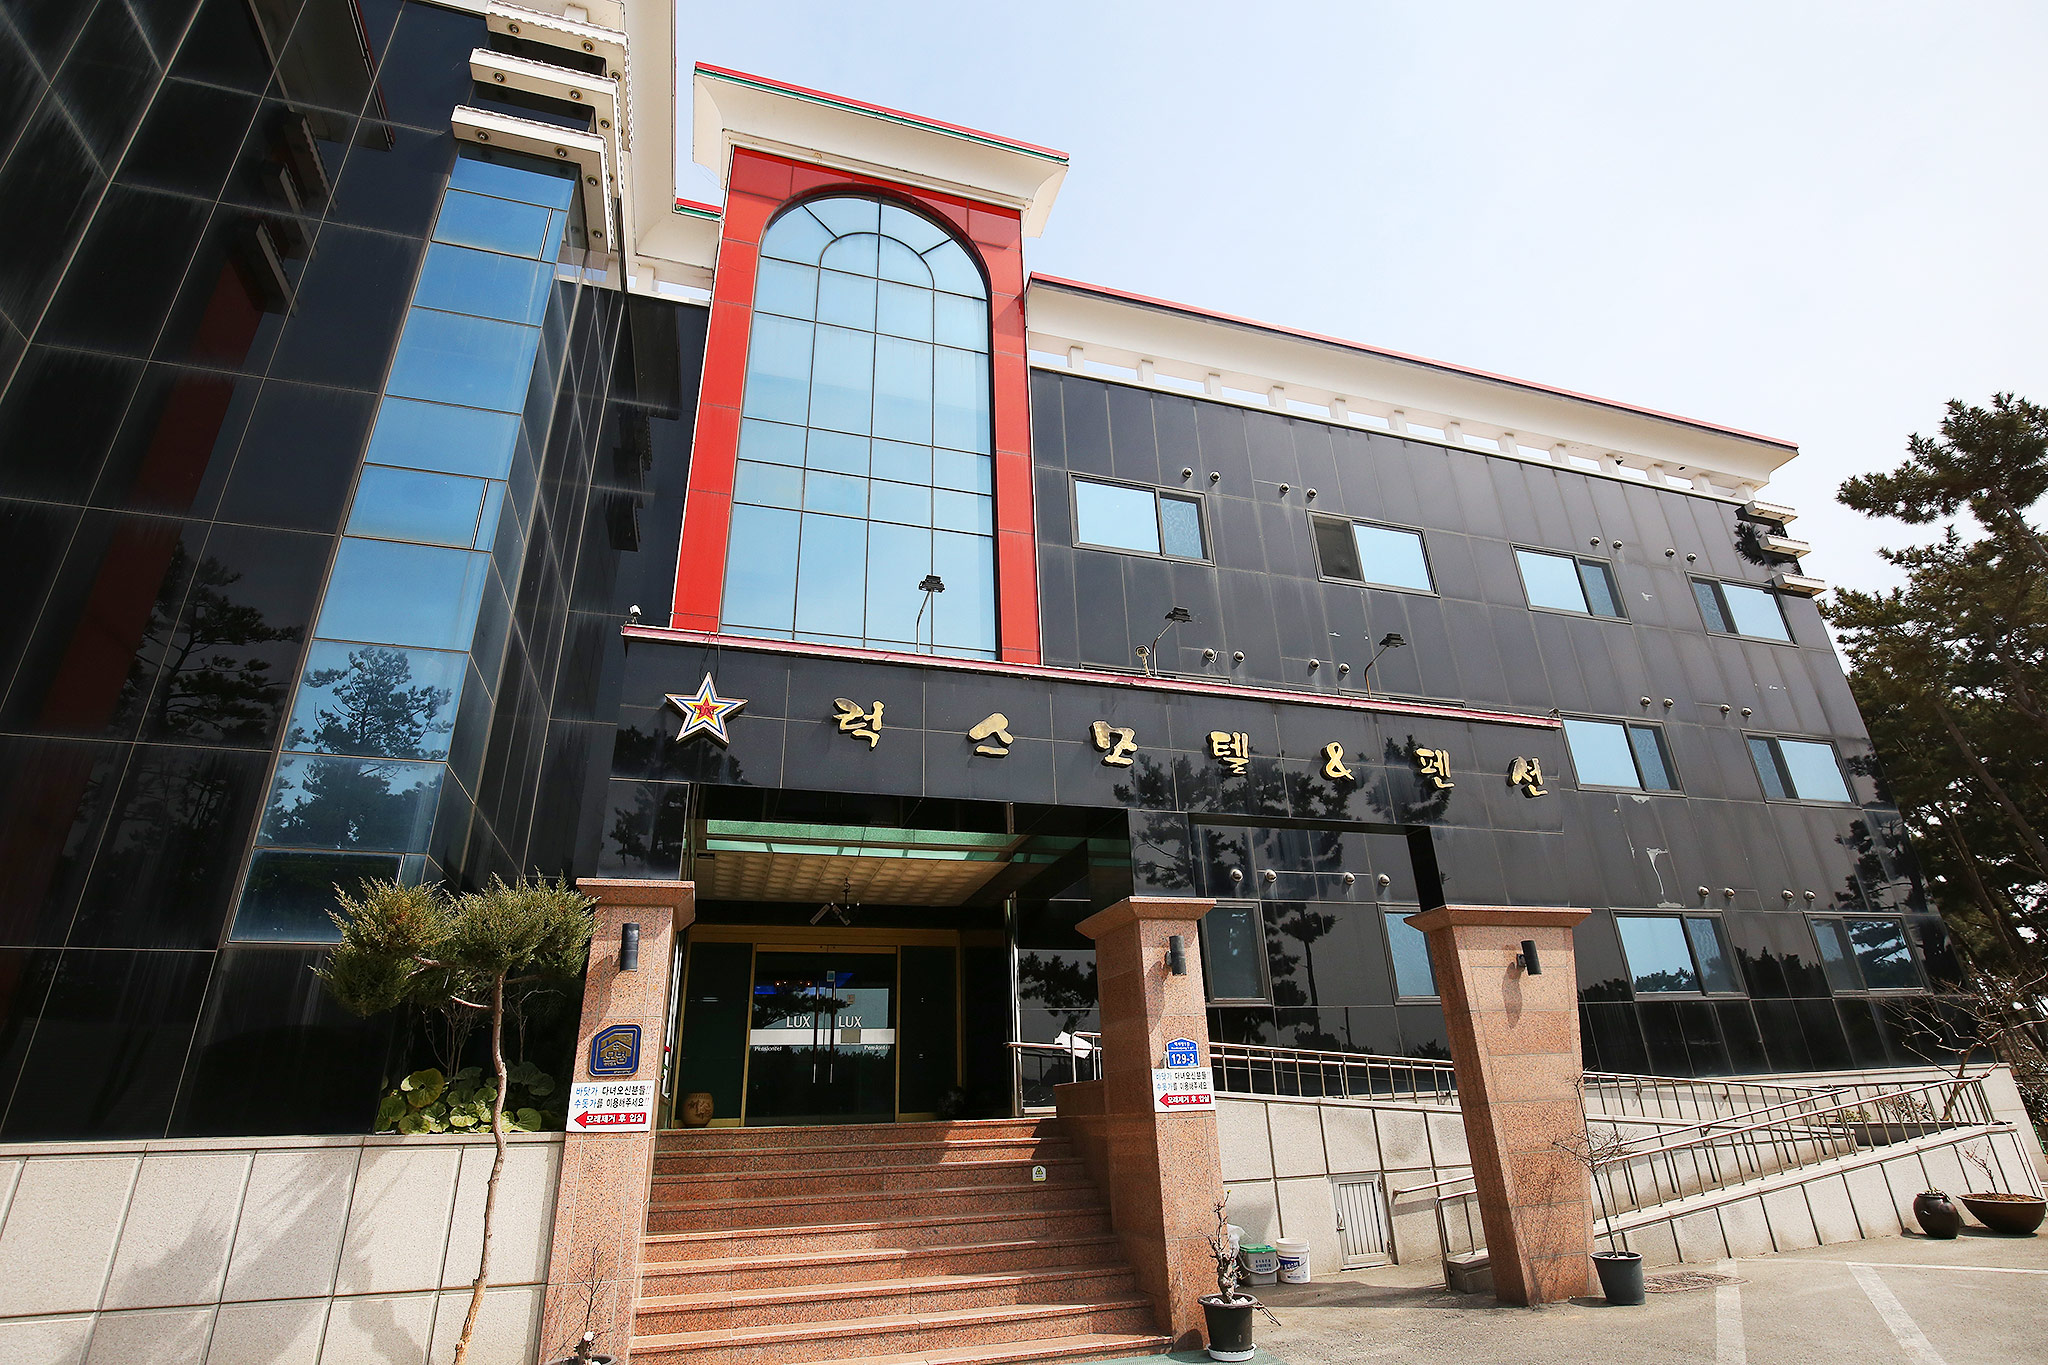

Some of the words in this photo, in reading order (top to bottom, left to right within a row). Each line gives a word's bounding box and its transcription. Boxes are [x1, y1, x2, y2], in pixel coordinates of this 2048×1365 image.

[1321, 741, 1355, 781] &
[786, 1015, 811, 1028] LUX
[838, 1015, 862, 1028] LUX
[1171, 1053, 1195, 1064] 129-3
[576, 1086, 598, 1096] 바닷가
[629, 1114, 644, 1122] 입실
